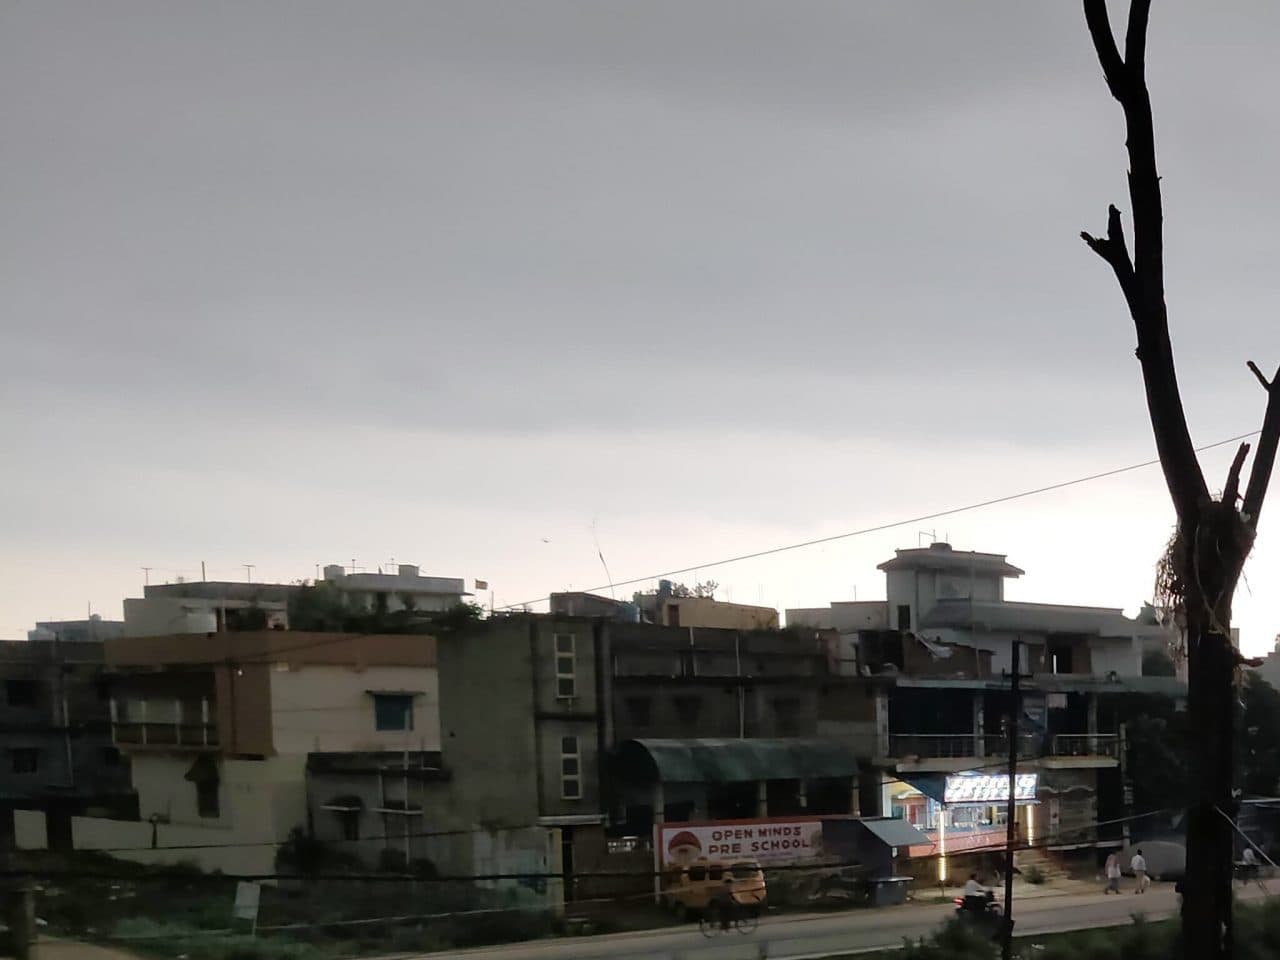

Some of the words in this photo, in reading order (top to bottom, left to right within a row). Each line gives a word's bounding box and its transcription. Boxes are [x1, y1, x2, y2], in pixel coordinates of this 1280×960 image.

[712, 829, 753, 841] OPEN
[758, 827, 802, 837] MINDS
[709, 844, 742, 855] PRE
[751, 839, 810, 851] SCHOOL
